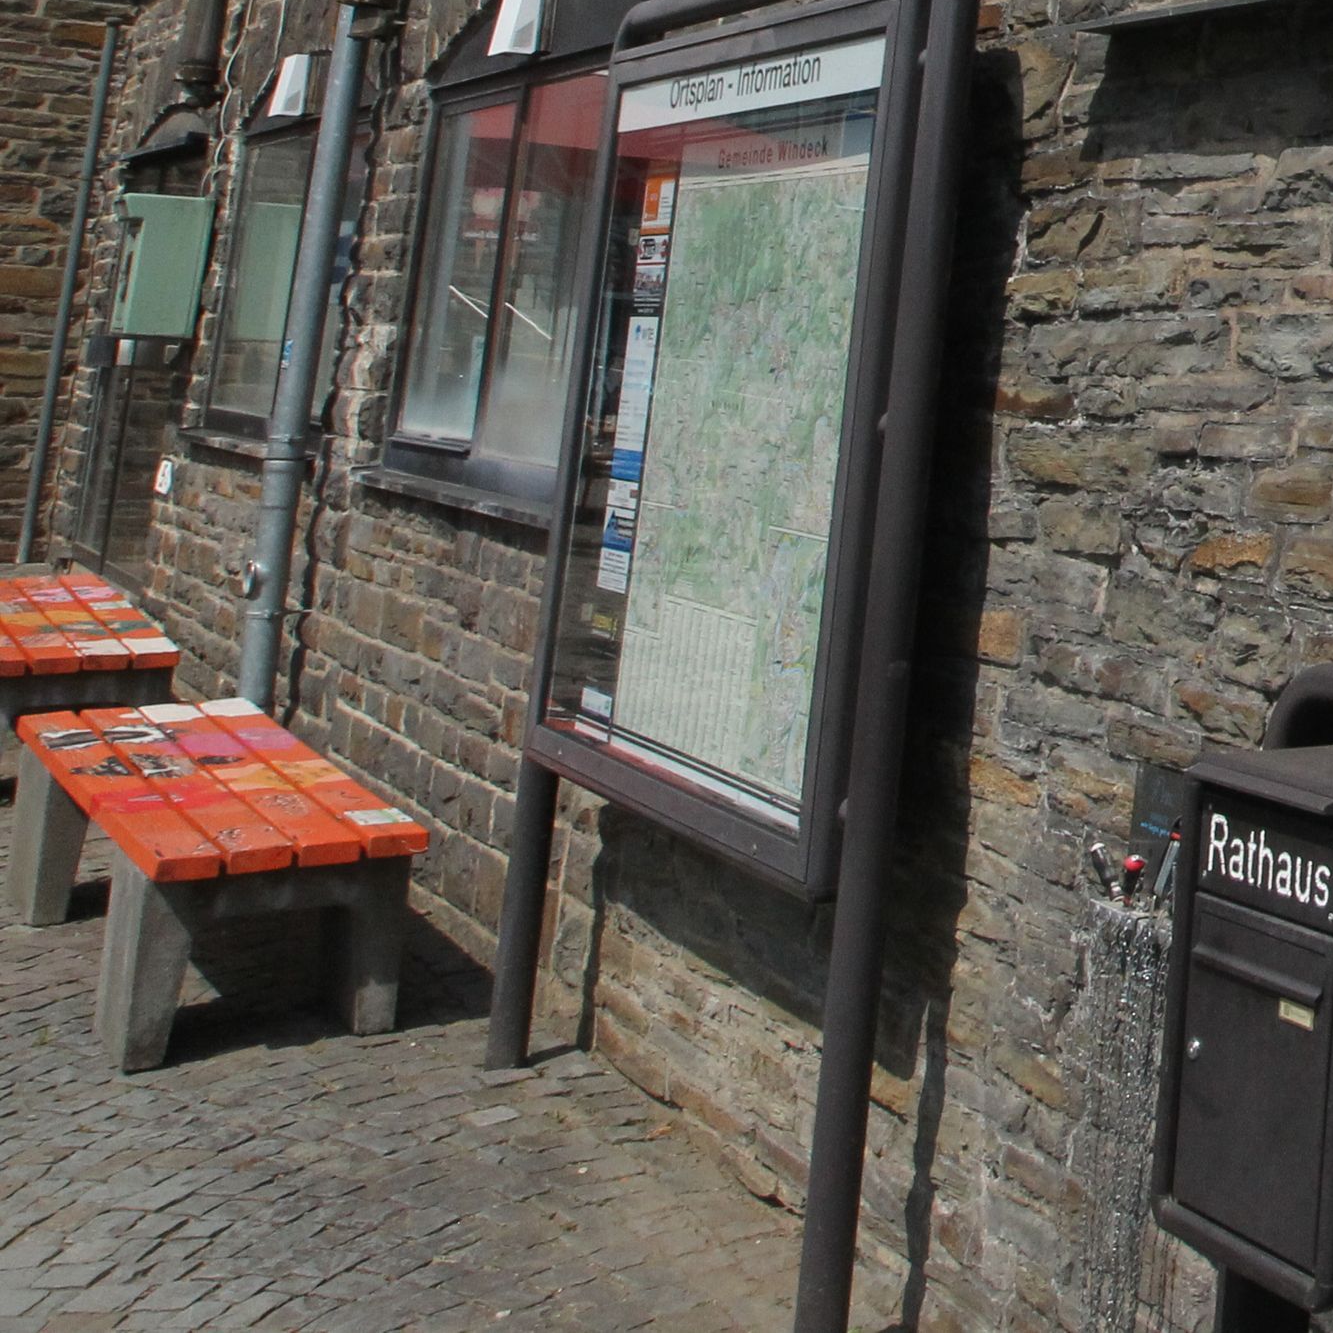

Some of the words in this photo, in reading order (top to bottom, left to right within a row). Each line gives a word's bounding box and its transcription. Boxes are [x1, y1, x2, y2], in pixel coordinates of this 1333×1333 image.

[669, 70, 724, 112] Ortsplan
[736, 54, 821, 97] Information
[718, 146, 773, 169] Gemeinde
[777, 135, 828, 162] Windeck
[1207, 813, 1331, 907] Rathaus
